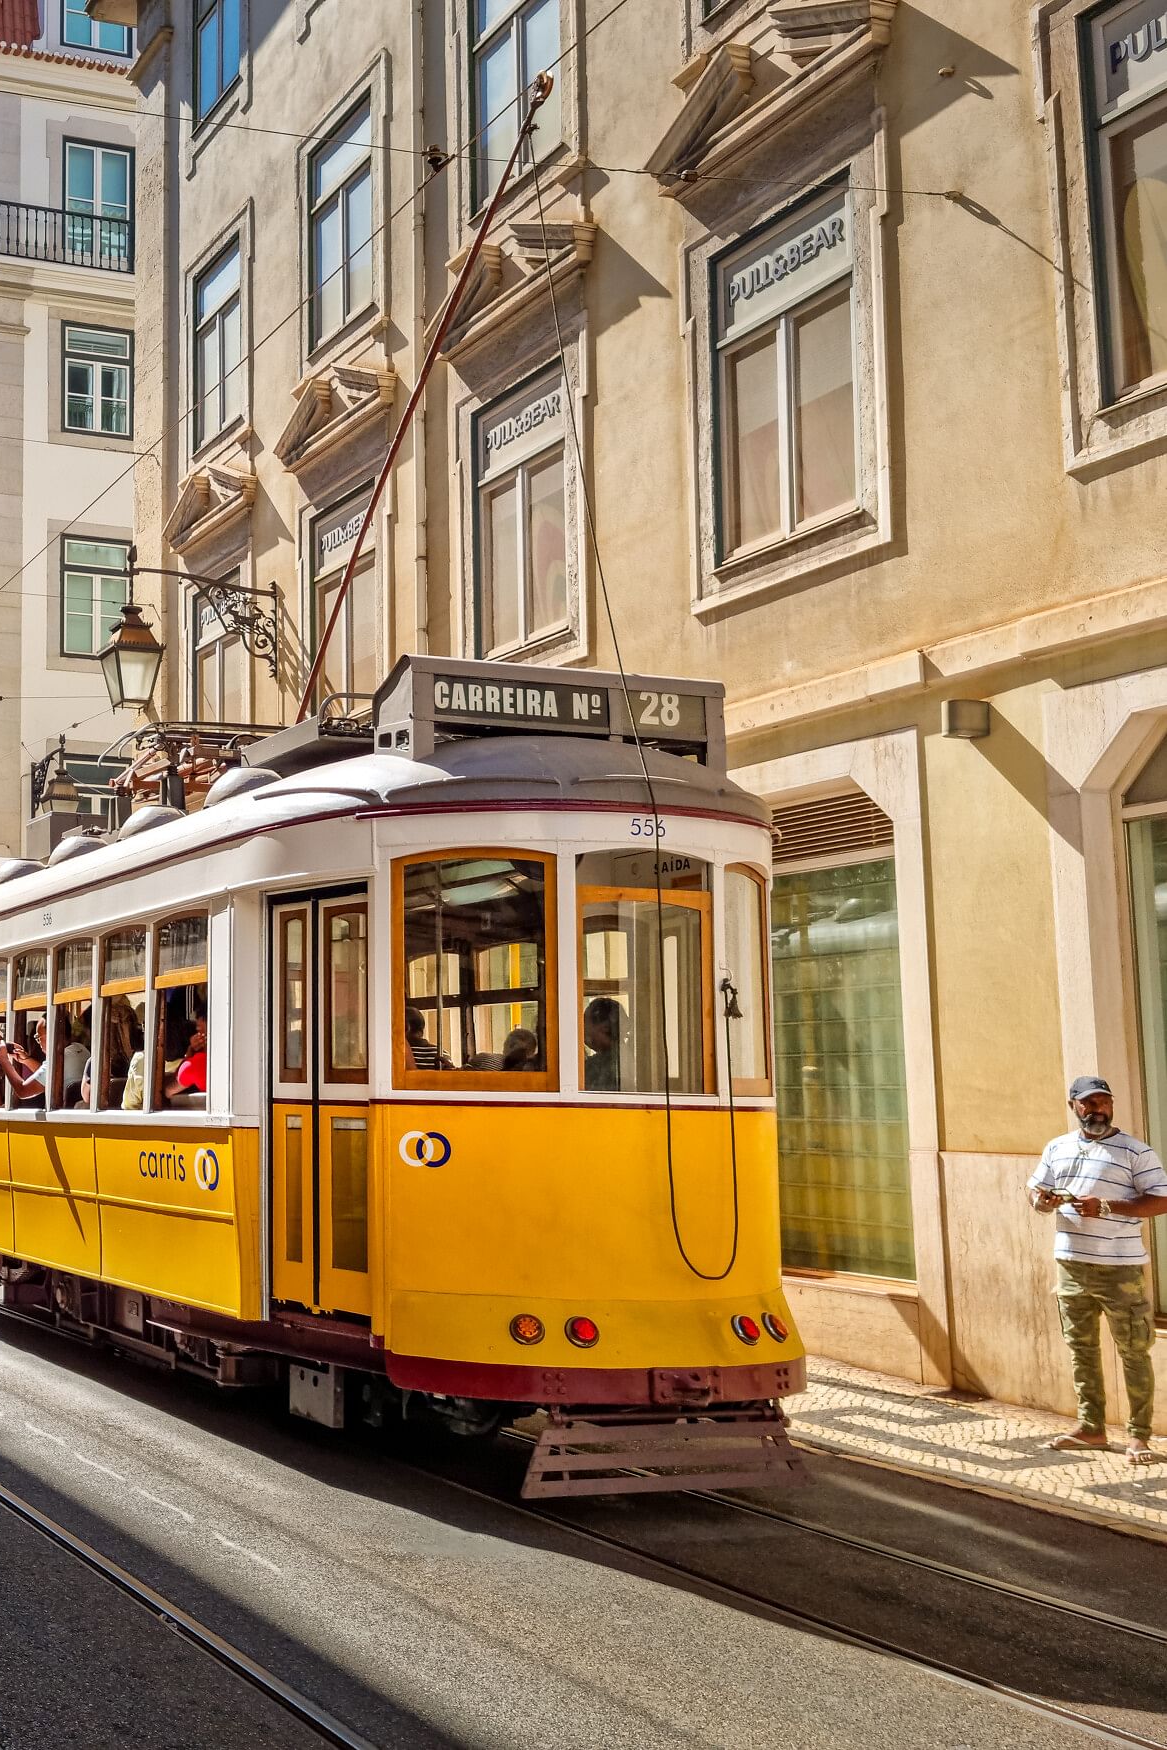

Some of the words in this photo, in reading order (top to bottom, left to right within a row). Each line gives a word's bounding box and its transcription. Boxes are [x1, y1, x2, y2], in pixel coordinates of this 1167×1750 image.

[729, 217, 844, 307] PULL&BEAR
[486, 392, 561, 453] PULL&BEAR
[434, 681, 558, 718] CARREIRA
[572, 692, 601, 720] Nº
[639, 691, 680, 727] 28
[630, 818, 666, 838] 556
[654, 856, 691, 875] SAÍDA
[42, 911, 53, 927] 556
[139, 1143, 186, 1182] carris
